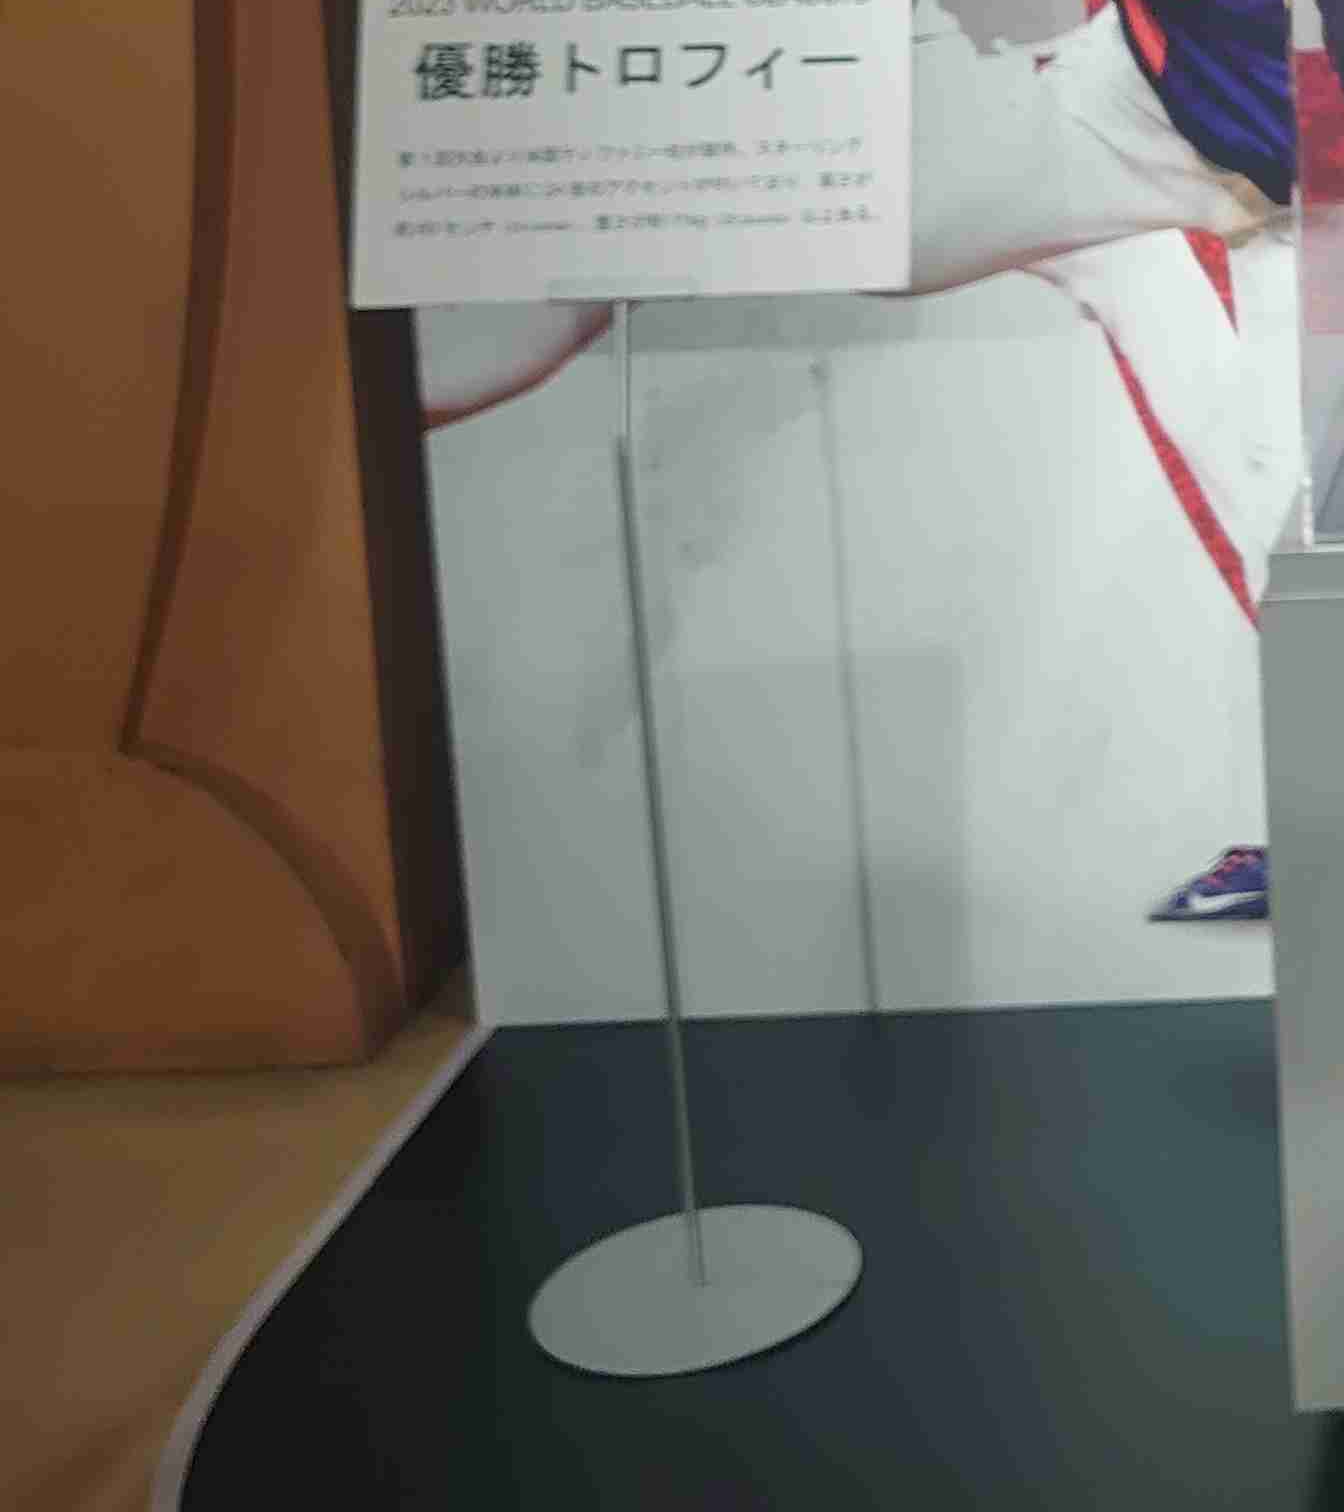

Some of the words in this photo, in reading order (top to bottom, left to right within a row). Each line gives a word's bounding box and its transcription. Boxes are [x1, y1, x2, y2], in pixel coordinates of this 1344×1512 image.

[414, 39, 861, 102] 優勝トロフィー
